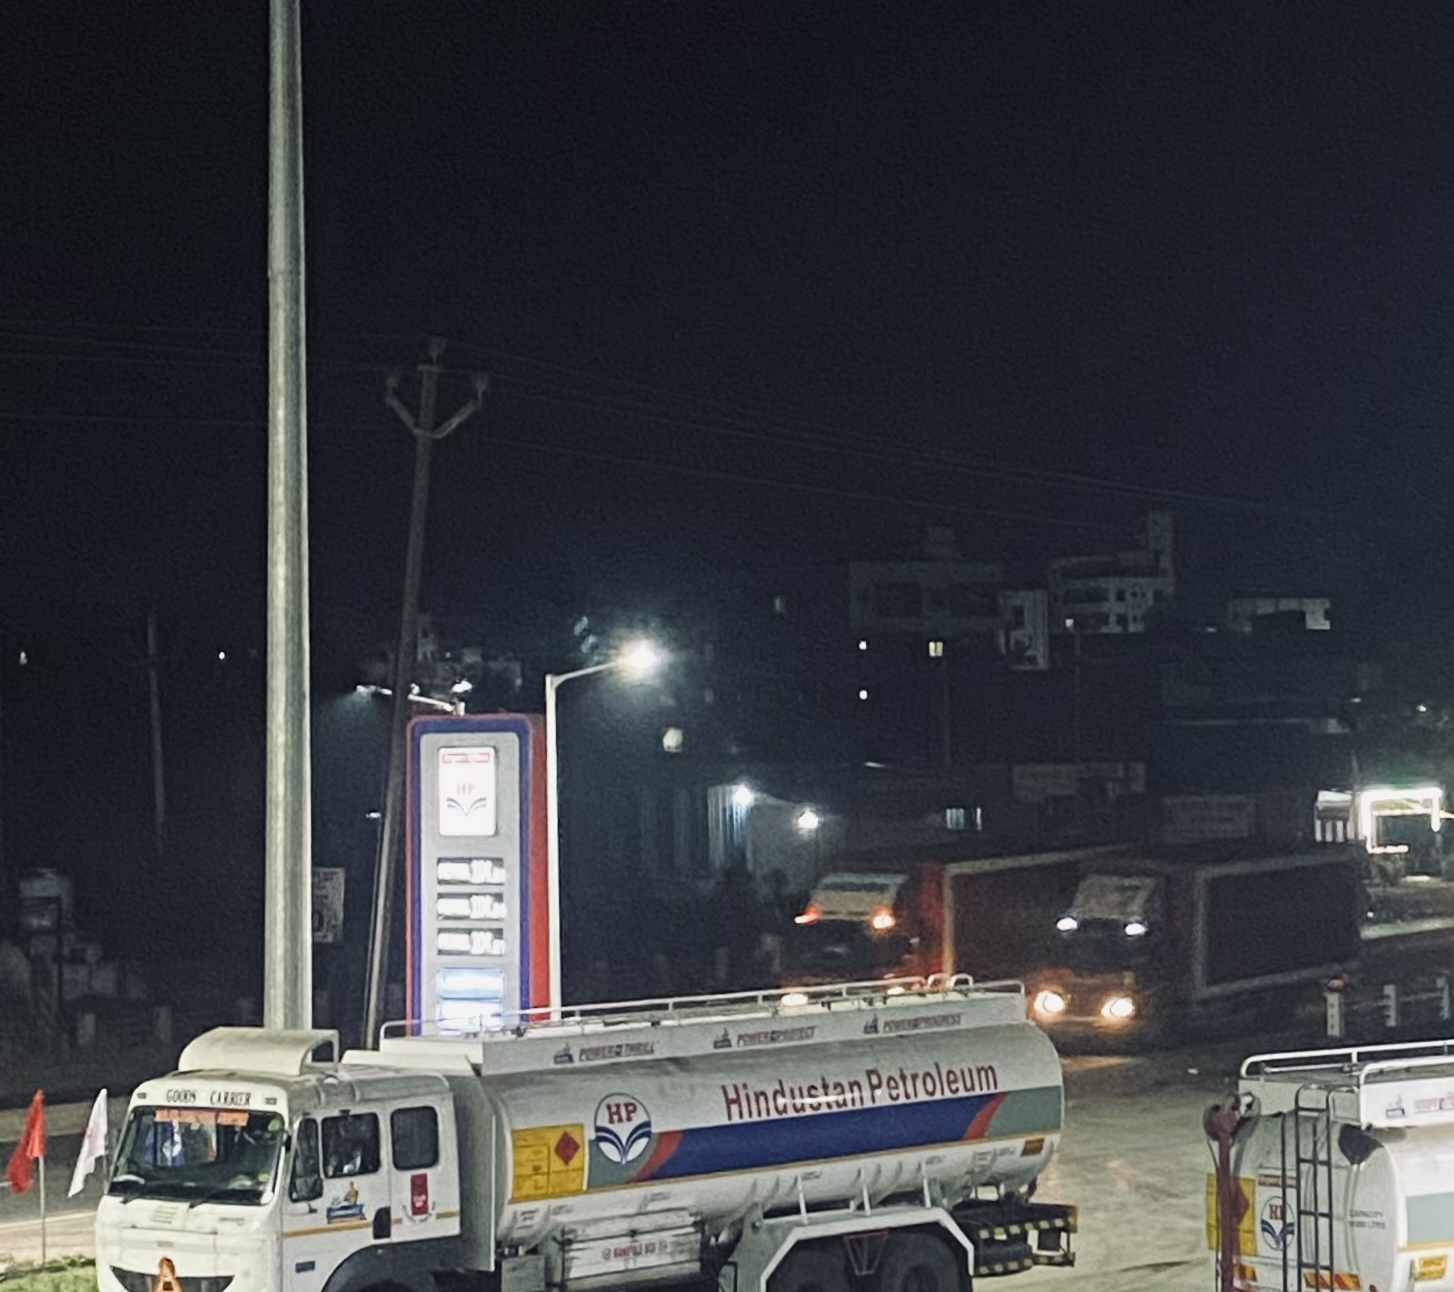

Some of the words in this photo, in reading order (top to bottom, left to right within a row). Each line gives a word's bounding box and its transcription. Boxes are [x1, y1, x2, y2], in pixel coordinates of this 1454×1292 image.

[166, 1089, 197, 1103] GOODS
[210, 1090, 251, 1106] CARRIER
[721, 1076, 865, 1121] Hindustan
[866, 1062, 999, 1104] Petroleum
[606, 1102, 638, 1124] HP
